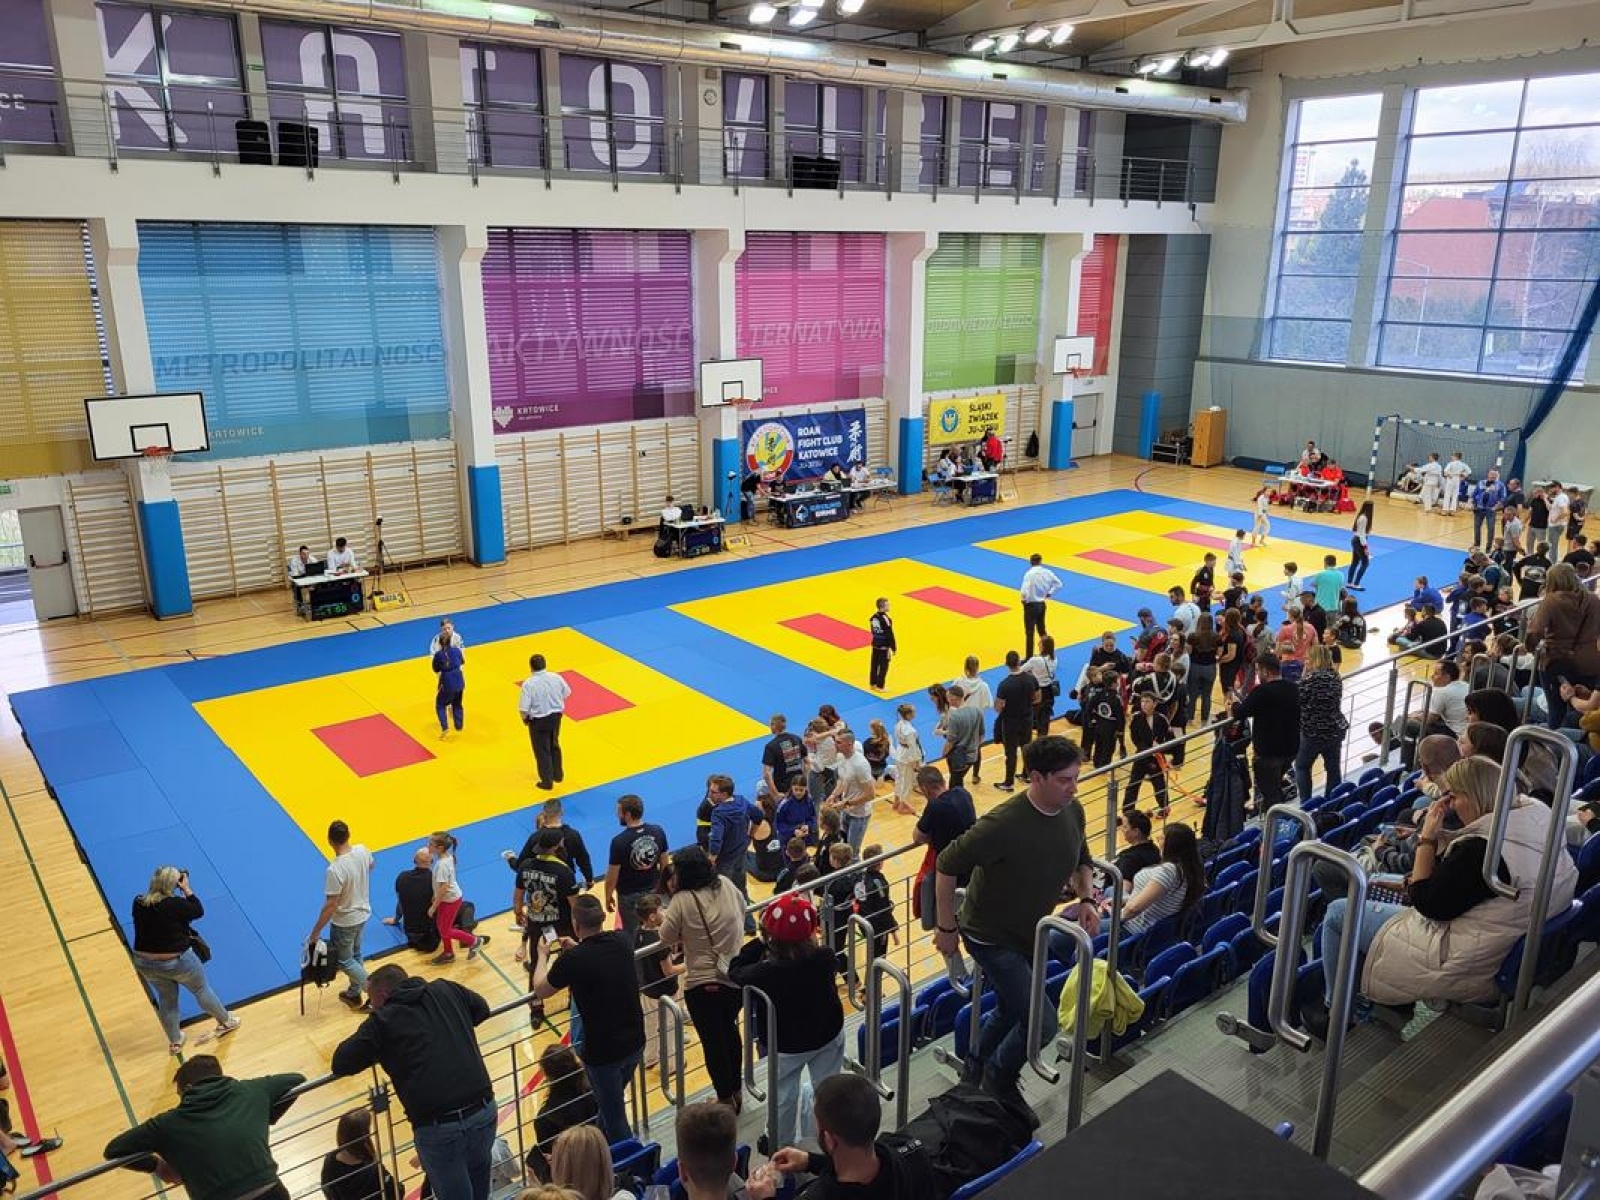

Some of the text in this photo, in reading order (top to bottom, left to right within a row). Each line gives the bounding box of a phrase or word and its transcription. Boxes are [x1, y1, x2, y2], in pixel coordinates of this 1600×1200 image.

[736, 317, 883, 348] LTERNATYWA
[797, 434, 843, 451] FIGHT CLUB
[798, 446, 838, 460] KATOWICE
